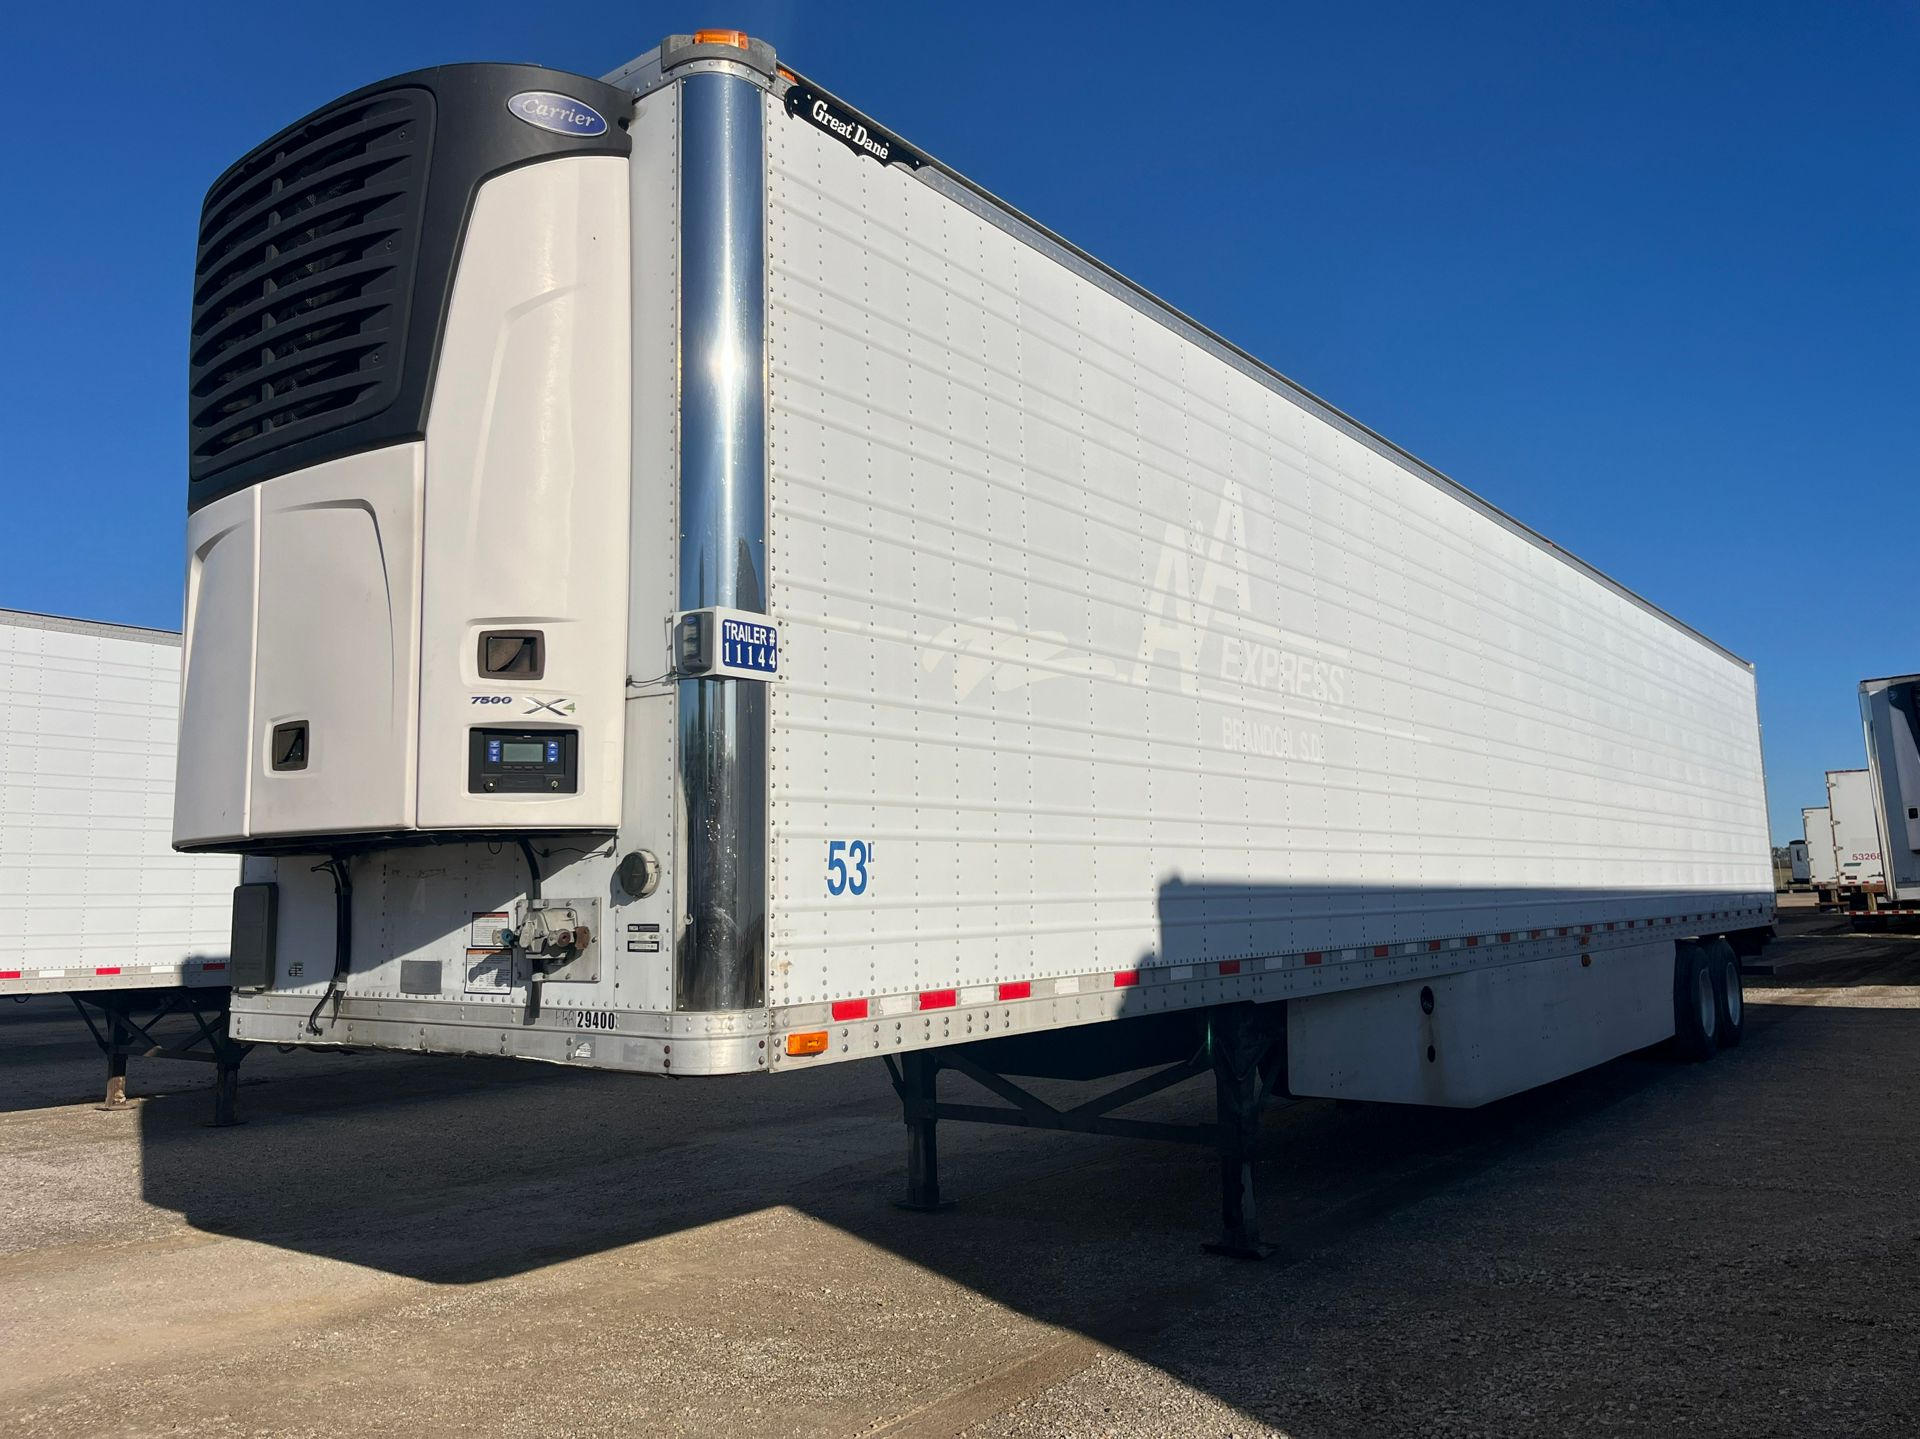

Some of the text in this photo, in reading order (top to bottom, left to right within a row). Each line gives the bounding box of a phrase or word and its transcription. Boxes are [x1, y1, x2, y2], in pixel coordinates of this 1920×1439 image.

[522, 99, 595, 127] Carrier
[812, 100, 889, 160] Great Dane
[724, 621, 776, 647] TRAILER #
[724, 642, 776, 669] 11144
[1220, 634, 1344, 710] EXPRESS
[471, 696, 512, 705] 7500
[576, 1011, 615, 1030] 29400
